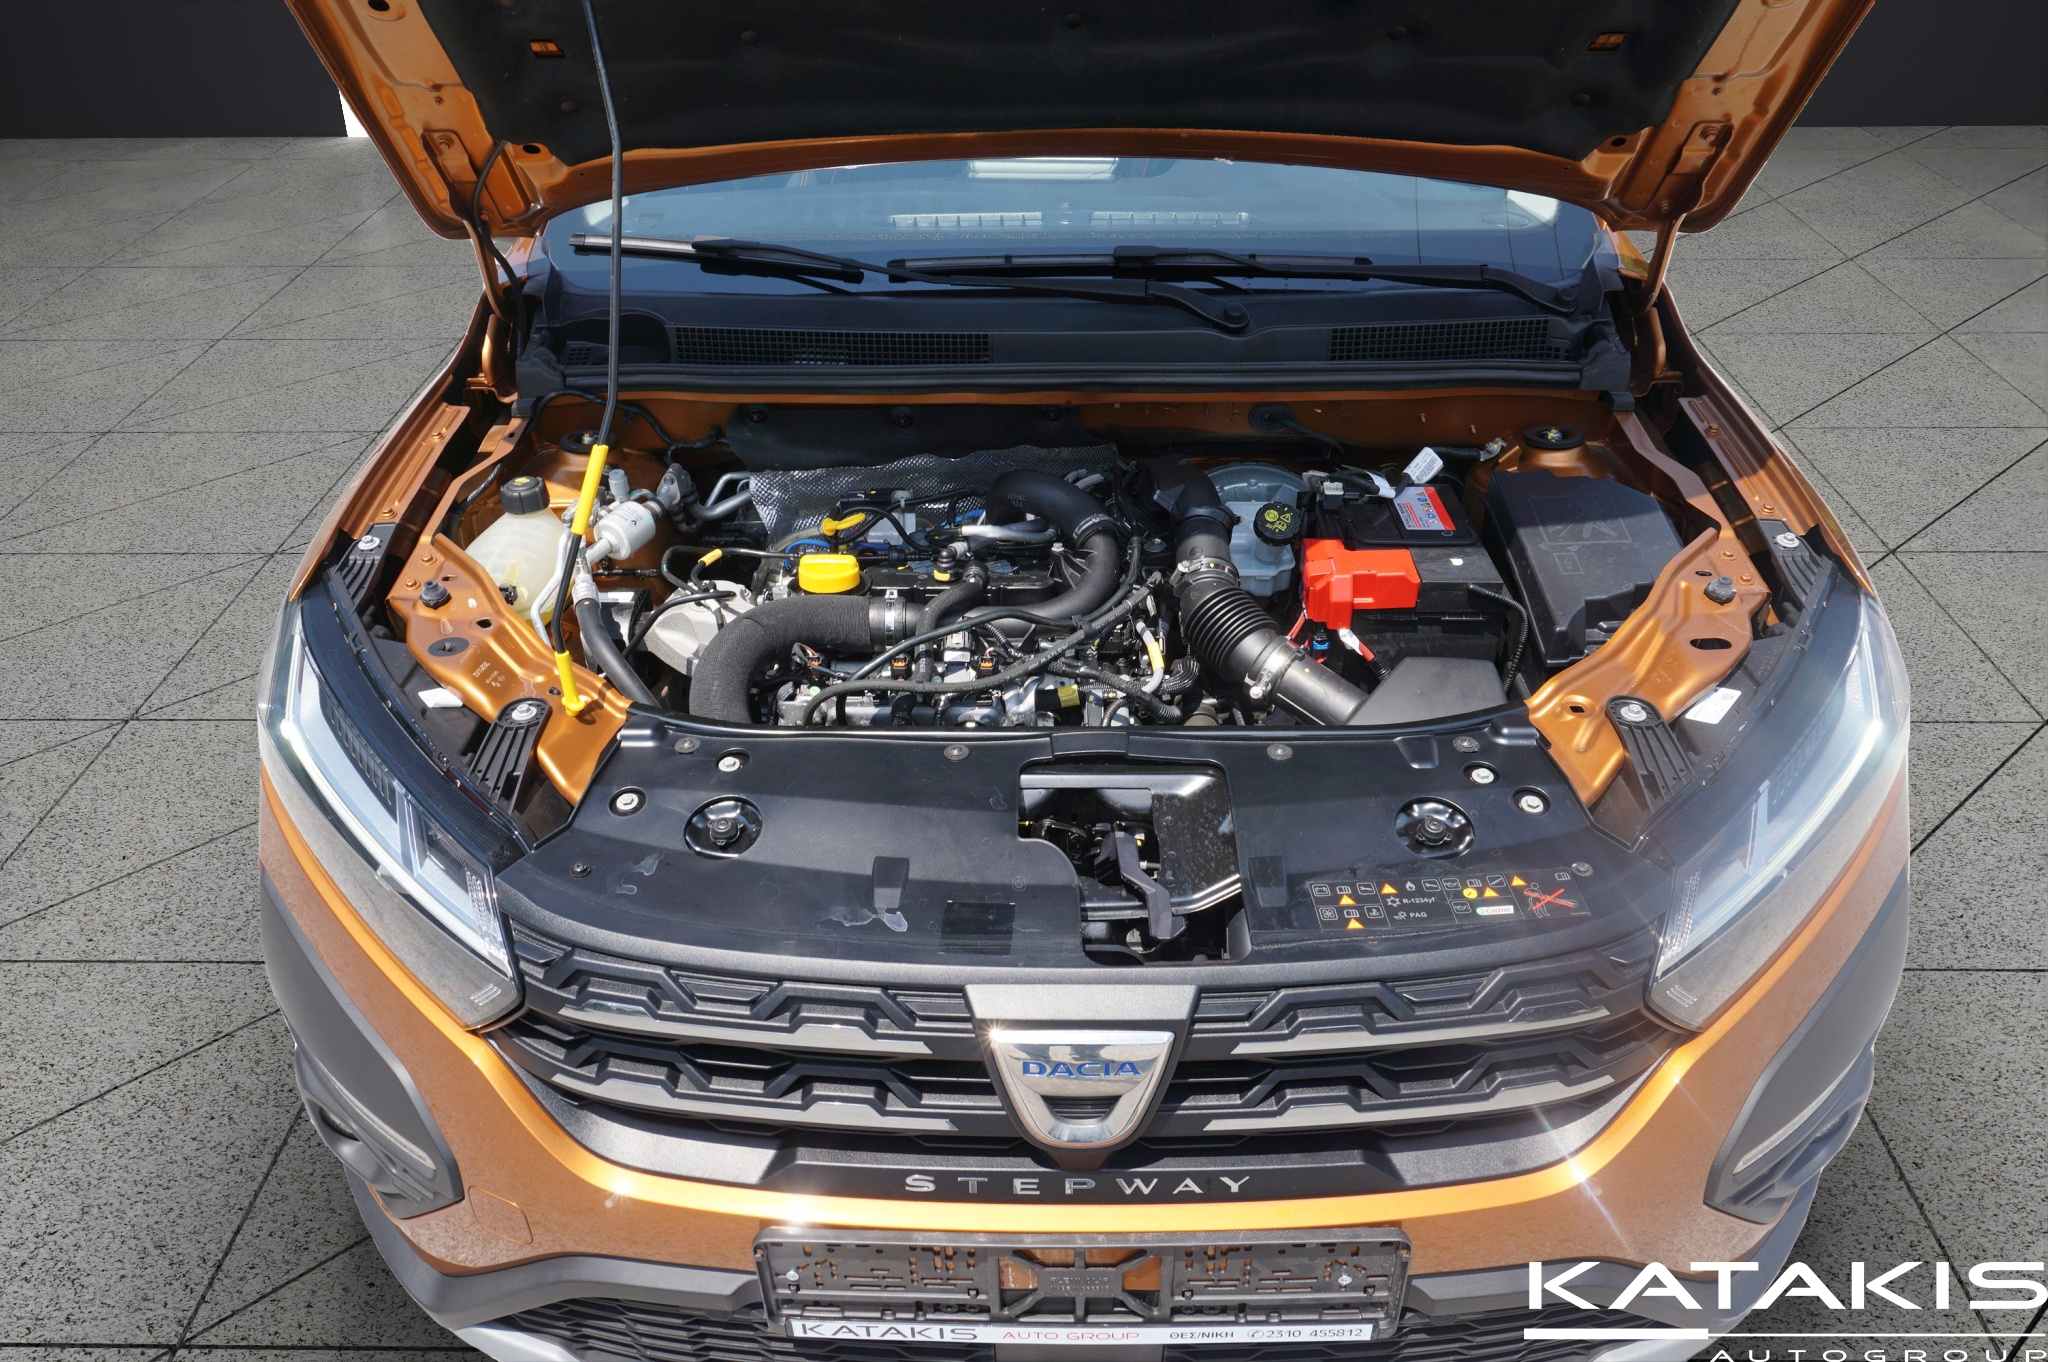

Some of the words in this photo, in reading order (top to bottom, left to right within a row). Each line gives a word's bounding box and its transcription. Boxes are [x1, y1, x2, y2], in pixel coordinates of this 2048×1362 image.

[1022, 1060, 1142, 1078] DACIA
[904, 1174, 1250, 1195] STEPWAY
[801, 1323, 978, 1341] KATAKIS
[1002, 1331, 1059, 1340] AUTO
[1066, 1331, 1140, 1340] GROUP
[1308, 1328, 1364, 1338] 455812
